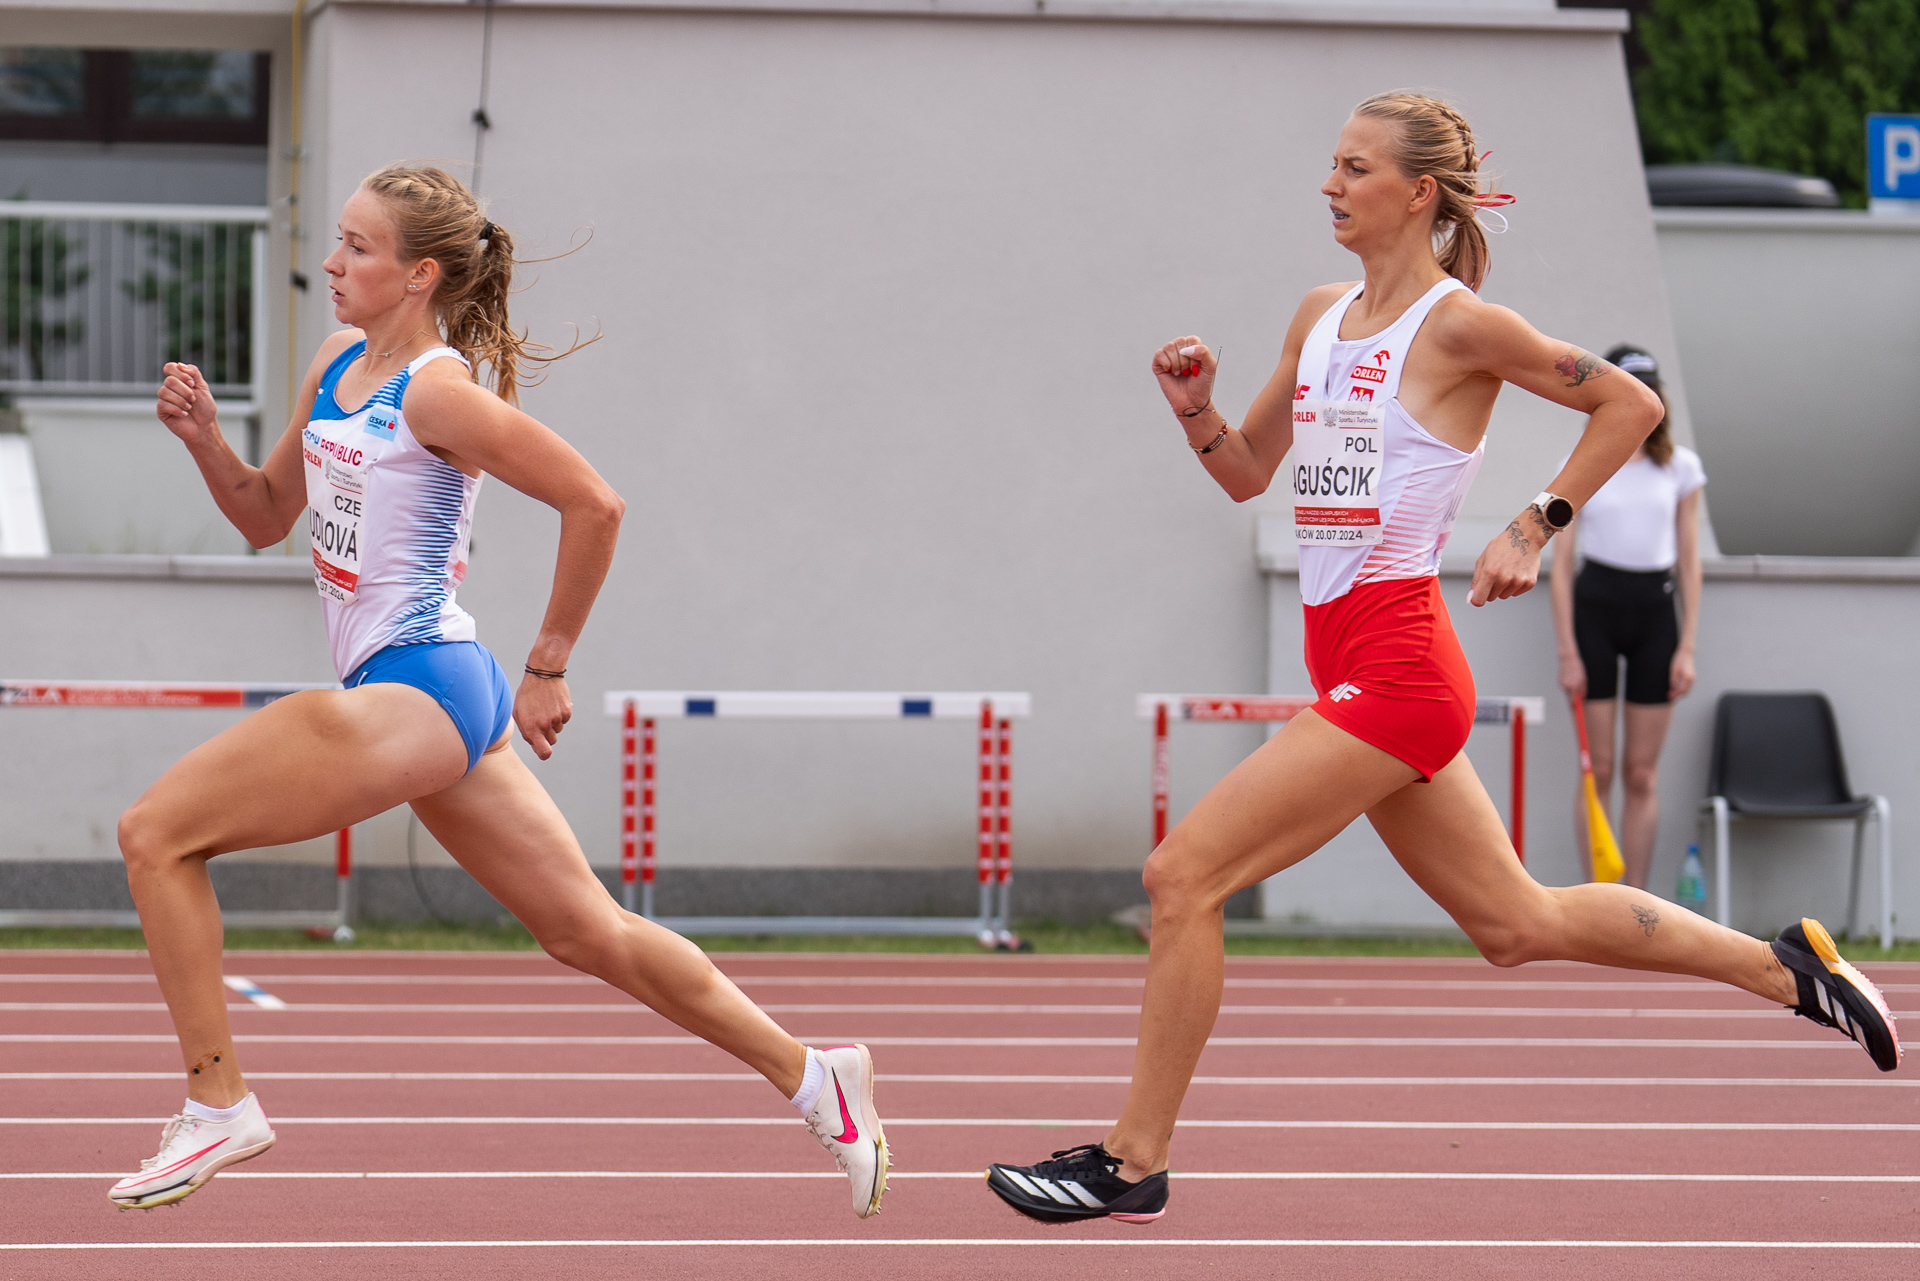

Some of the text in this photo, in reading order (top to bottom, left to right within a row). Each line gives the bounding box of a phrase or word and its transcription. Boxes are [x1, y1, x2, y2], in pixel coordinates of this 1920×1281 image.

[1884, 125, 1920, 191] P
[1353, 367, 1385, 381] ORLEN
[1344, 436, 1378, 453] POL
[334, 494, 362, 518] CZE
[1315, 529, 1364, 541] 20.07.2024
